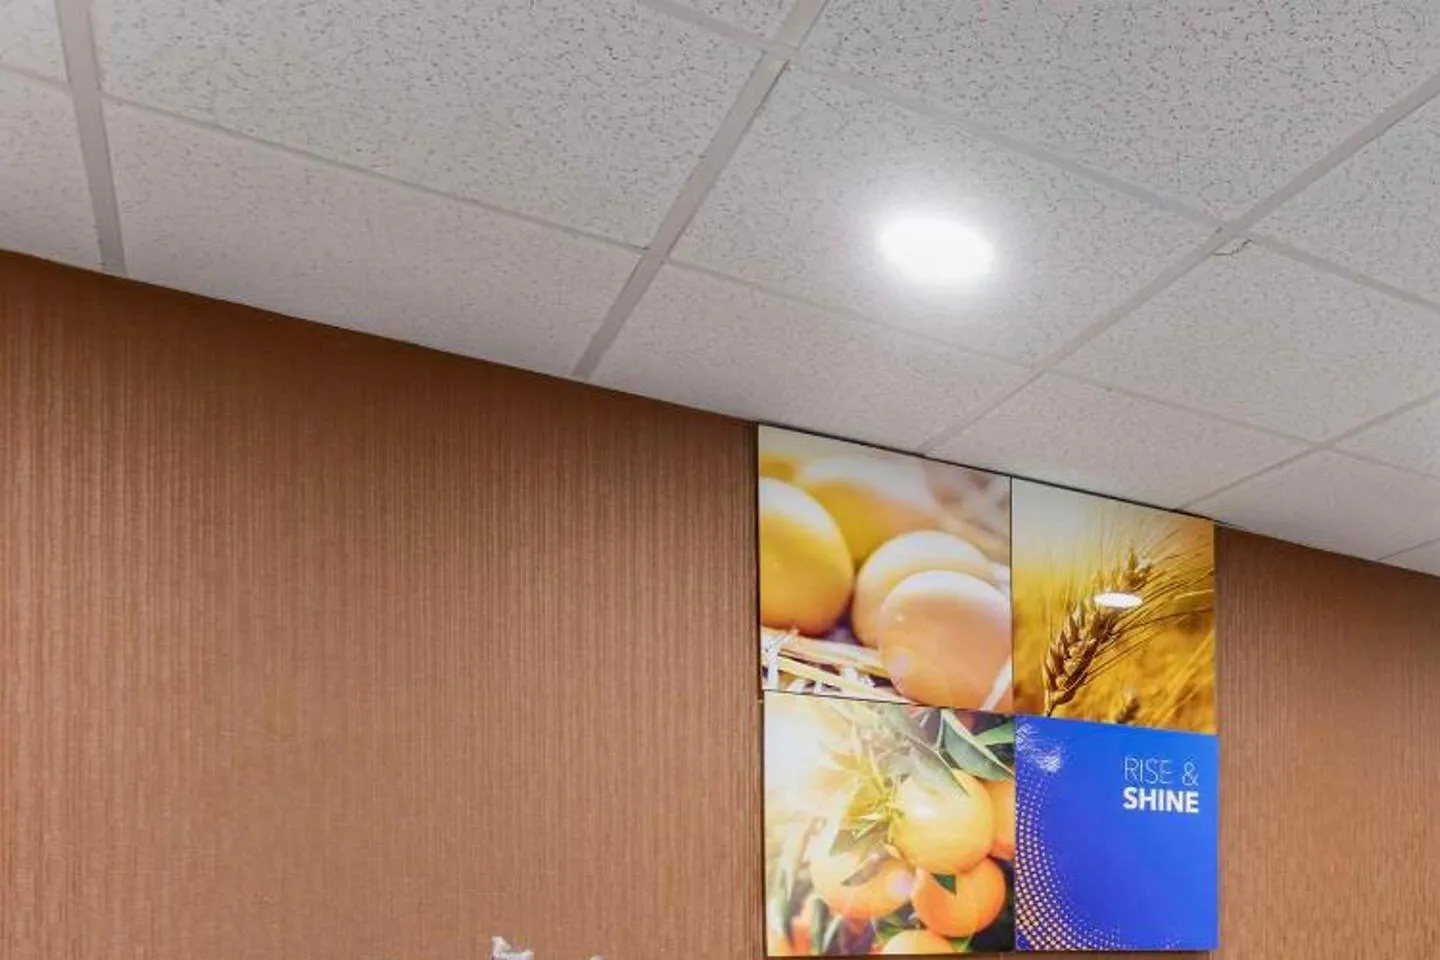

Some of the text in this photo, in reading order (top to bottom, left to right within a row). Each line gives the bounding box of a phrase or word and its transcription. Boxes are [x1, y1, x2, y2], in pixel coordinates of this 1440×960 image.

[1124, 756, 1199, 786] RISE &
[1123, 786, 1199, 814] SHINE
